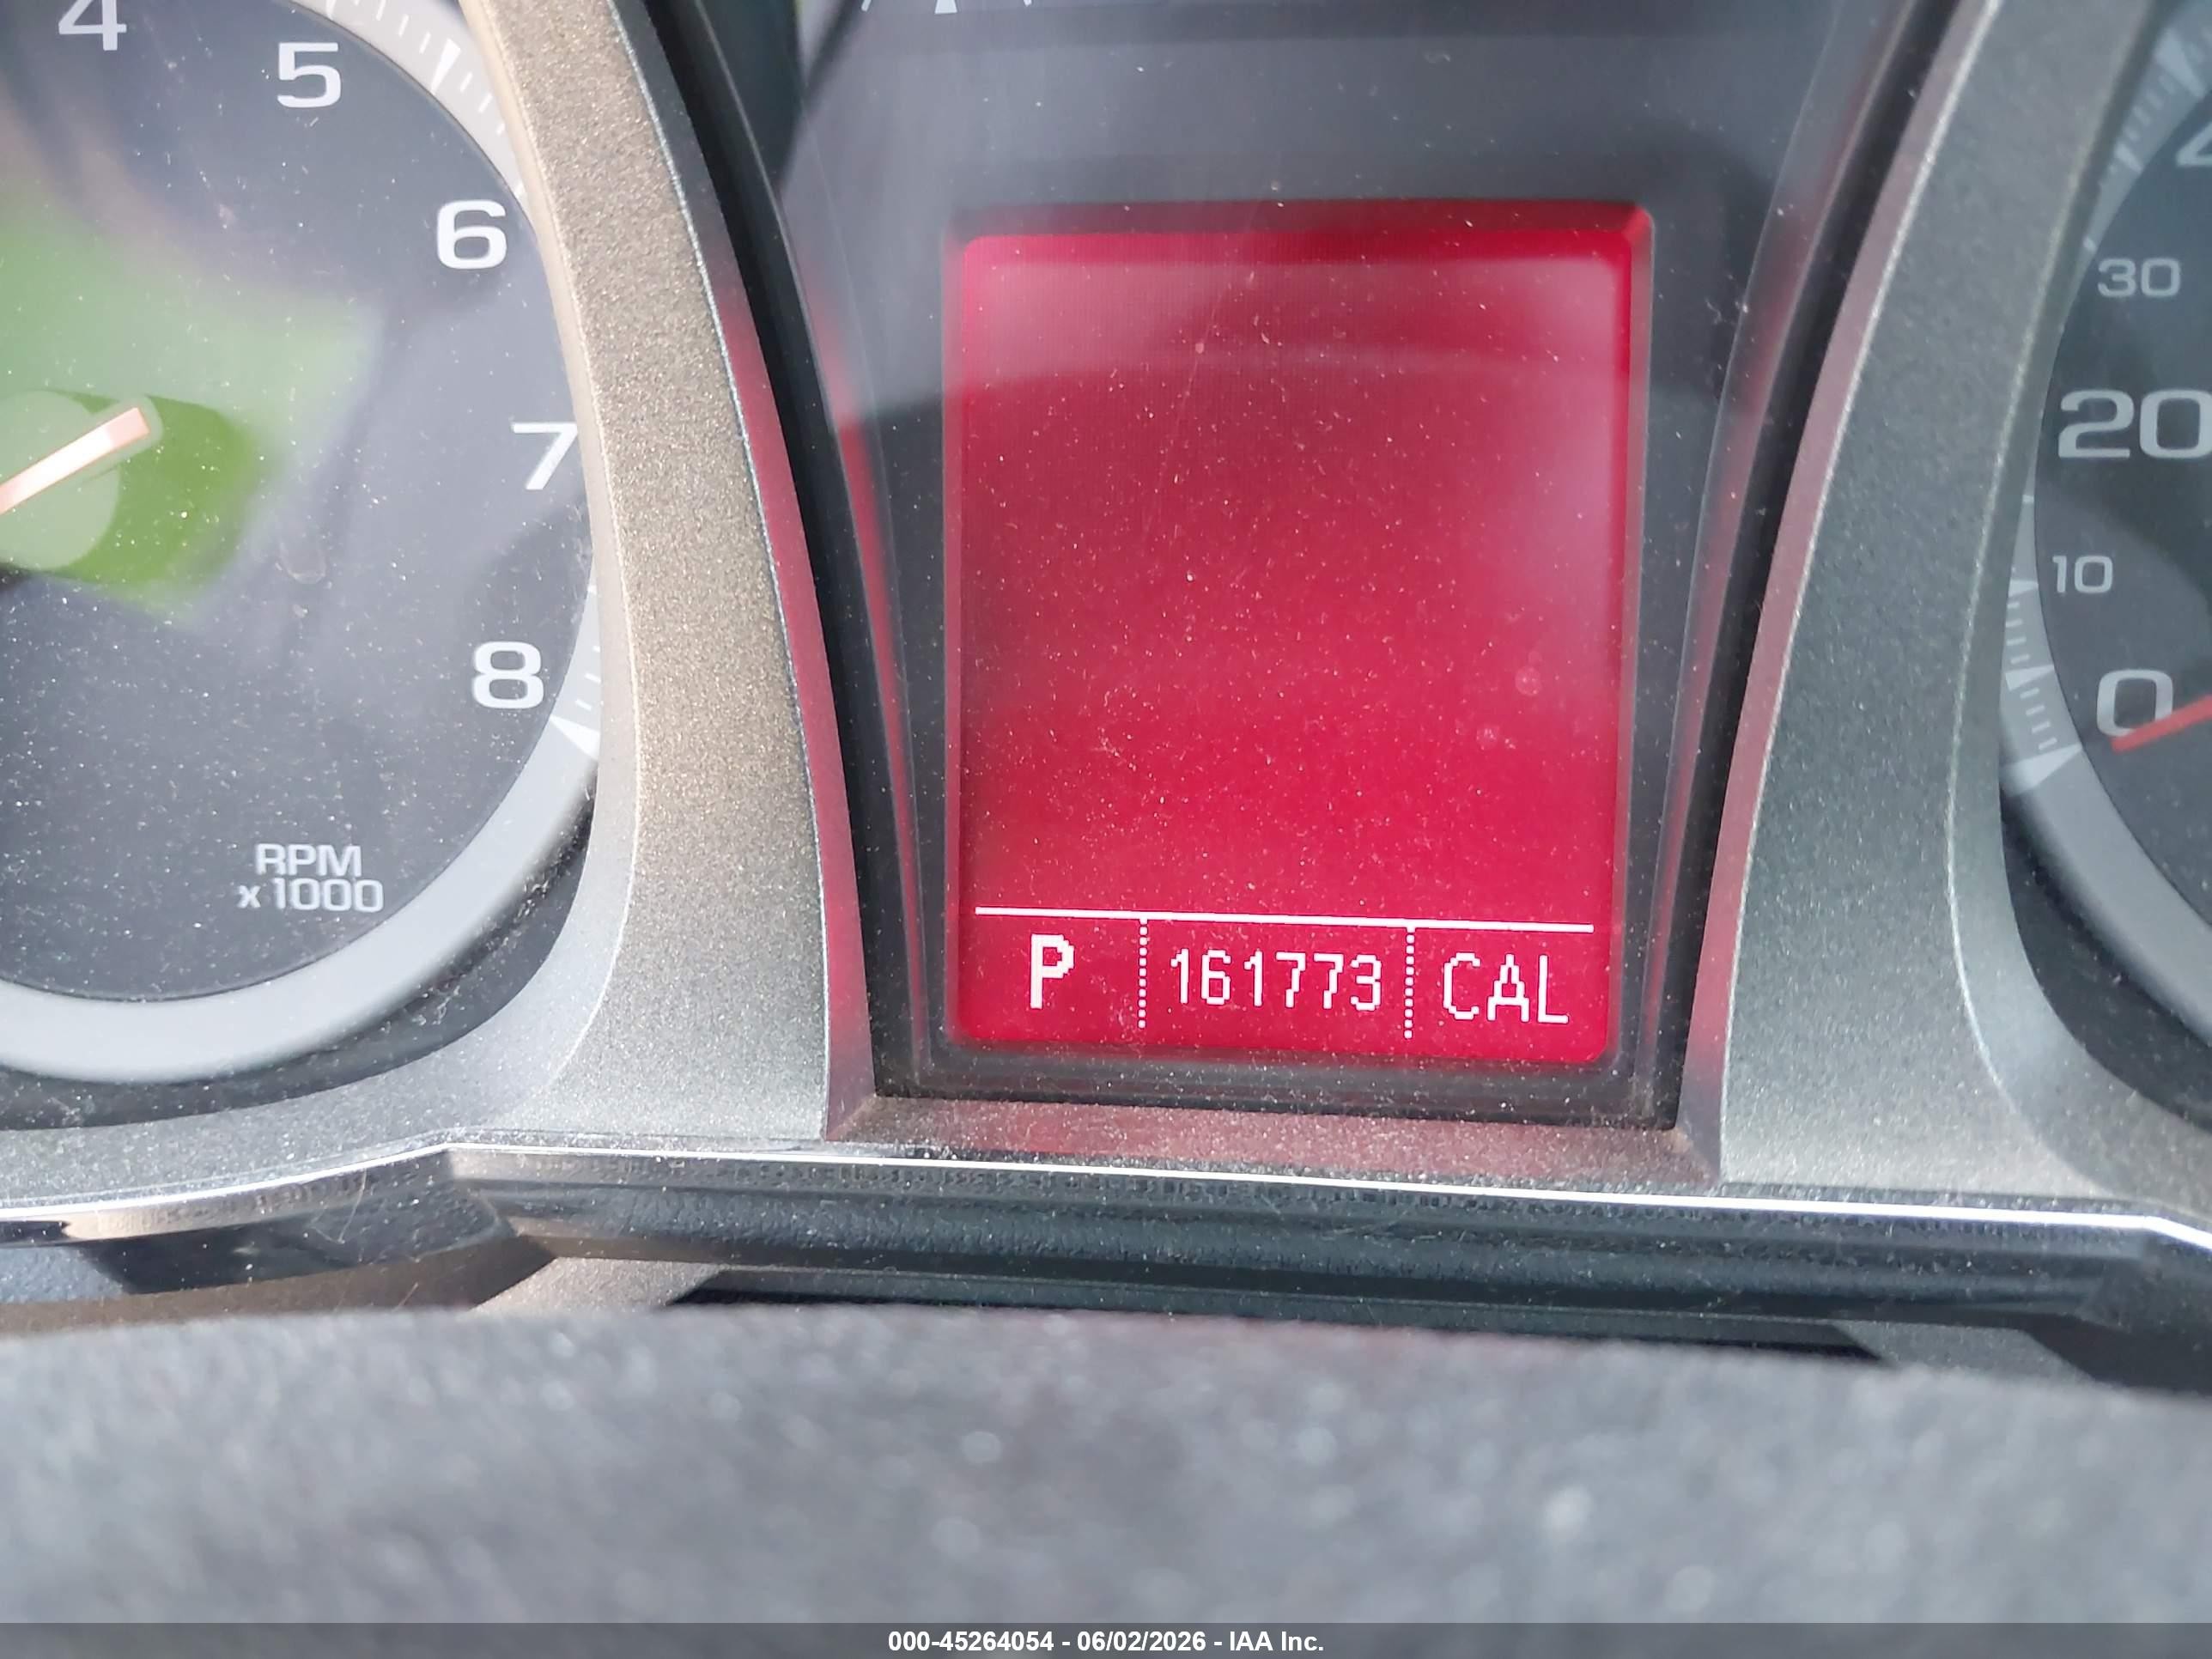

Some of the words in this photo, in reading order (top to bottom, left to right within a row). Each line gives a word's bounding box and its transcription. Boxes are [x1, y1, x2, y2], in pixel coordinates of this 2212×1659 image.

[58, 0, 127, 51] 4
[276, 42, 342, 108] 5
[436, 199, 507, 270] 6
[2097, 258, 2181, 298] 30
[511, 422, 578, 490] 7
[2058, 389, 2212, 459] 20
[2052, 555, 2113, 594] 10
[472, 641, 544, 709] 8
[2096, 668, 2174, 738] 0
[256, 842, 363, 877] RPM
[1030, 934, 1074, 1009] P
[1170, 948, 1382, 1012] 161773
[1443, 952, 1569, 1024] CAL
